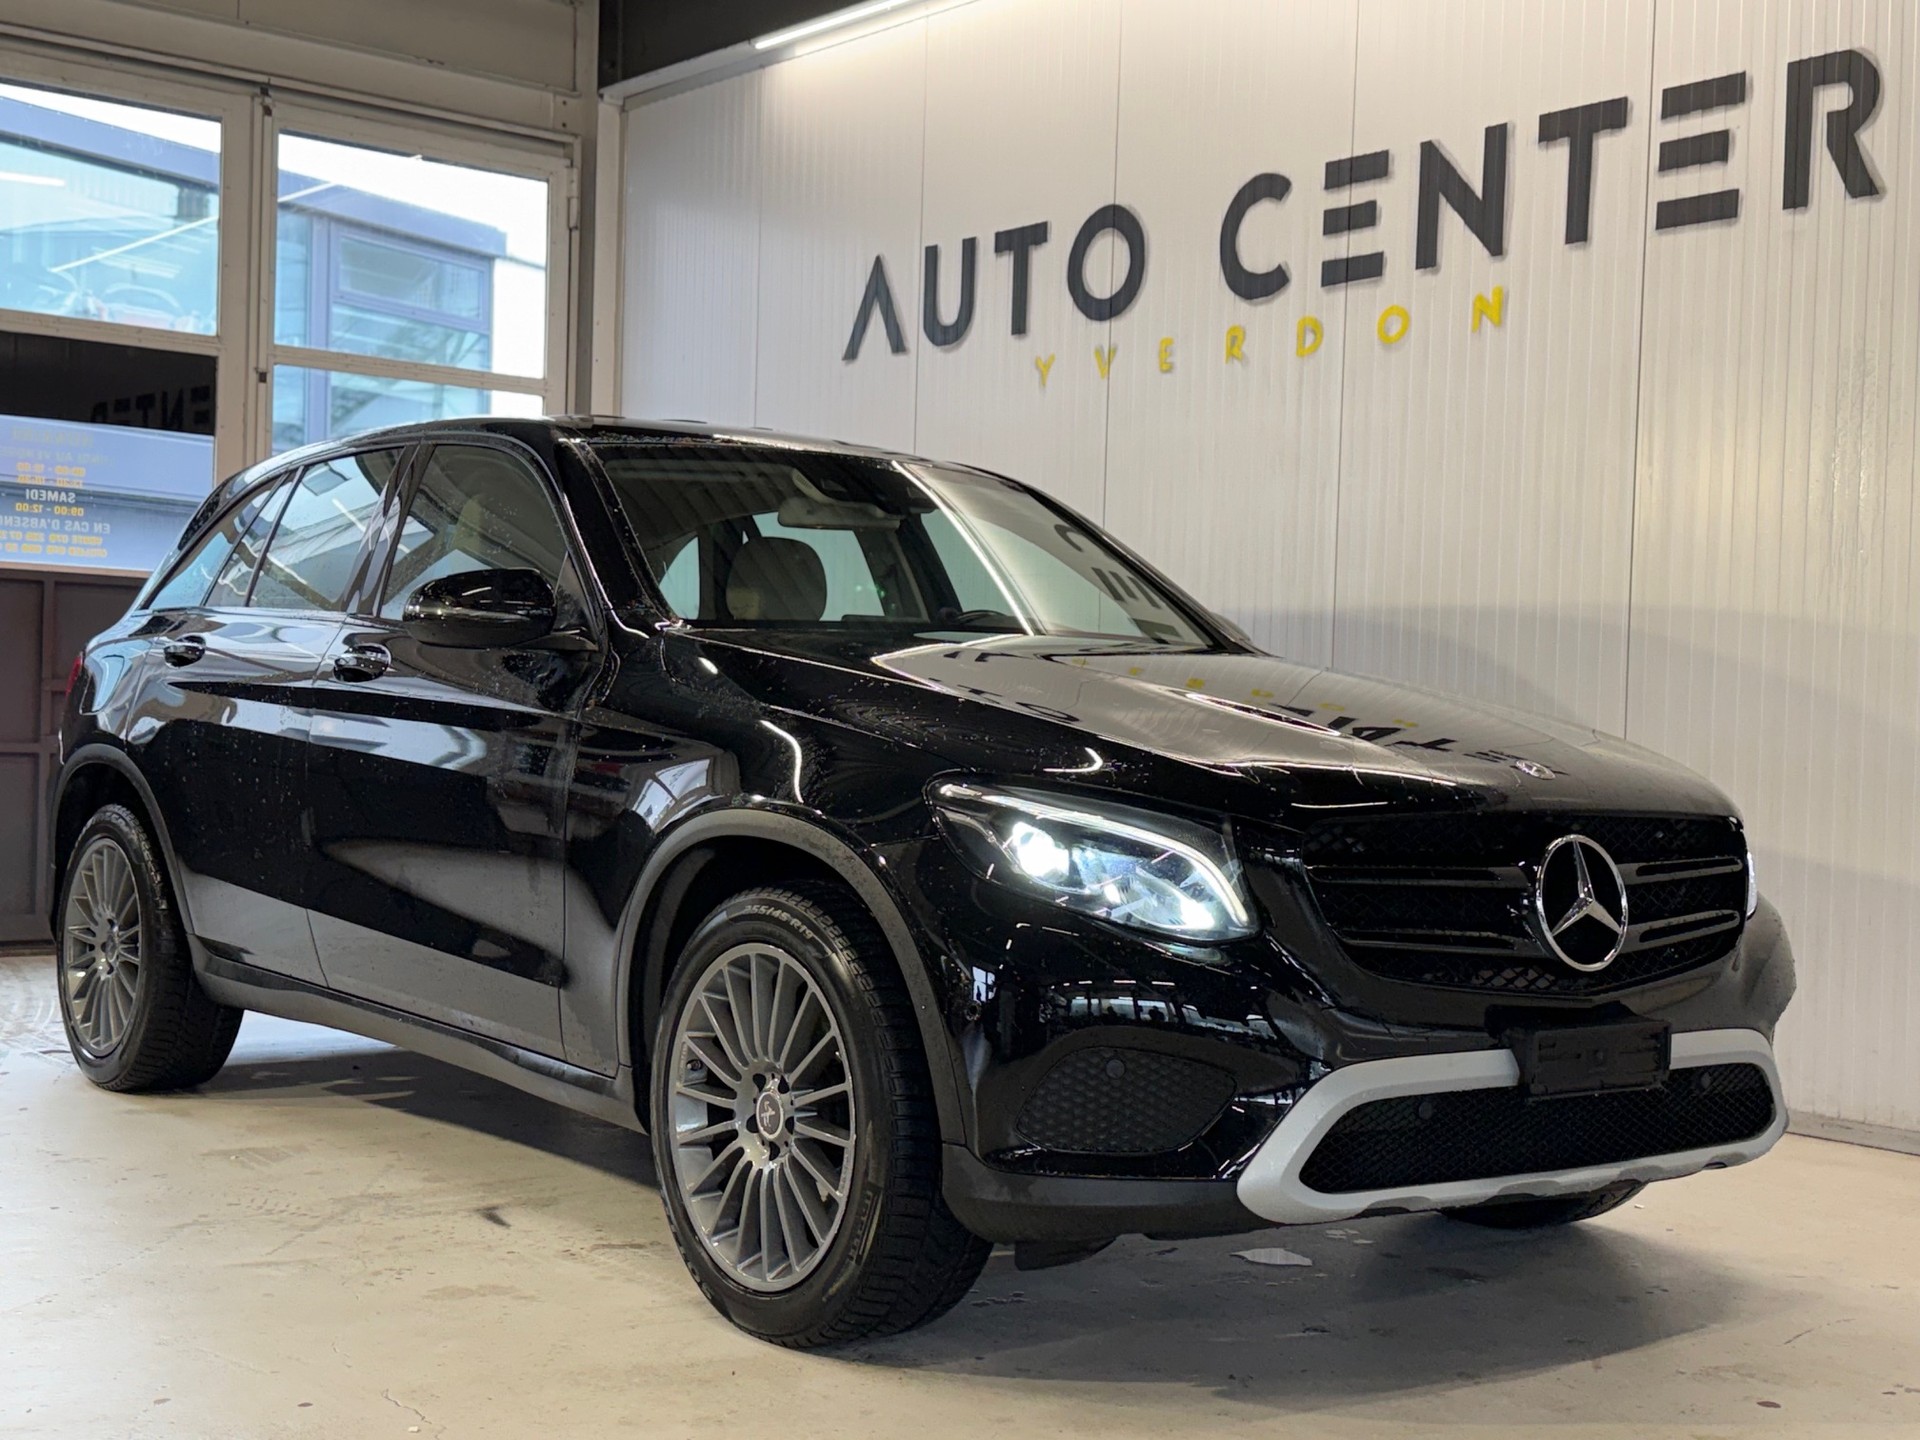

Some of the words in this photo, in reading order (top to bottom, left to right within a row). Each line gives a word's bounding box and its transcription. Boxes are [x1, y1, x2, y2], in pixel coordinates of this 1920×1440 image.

[844, 204, 1146, 361] AUTO
[1219, 49, 1884, 302] CENTER
[1035, 286, 1505, 386] YVERDON
